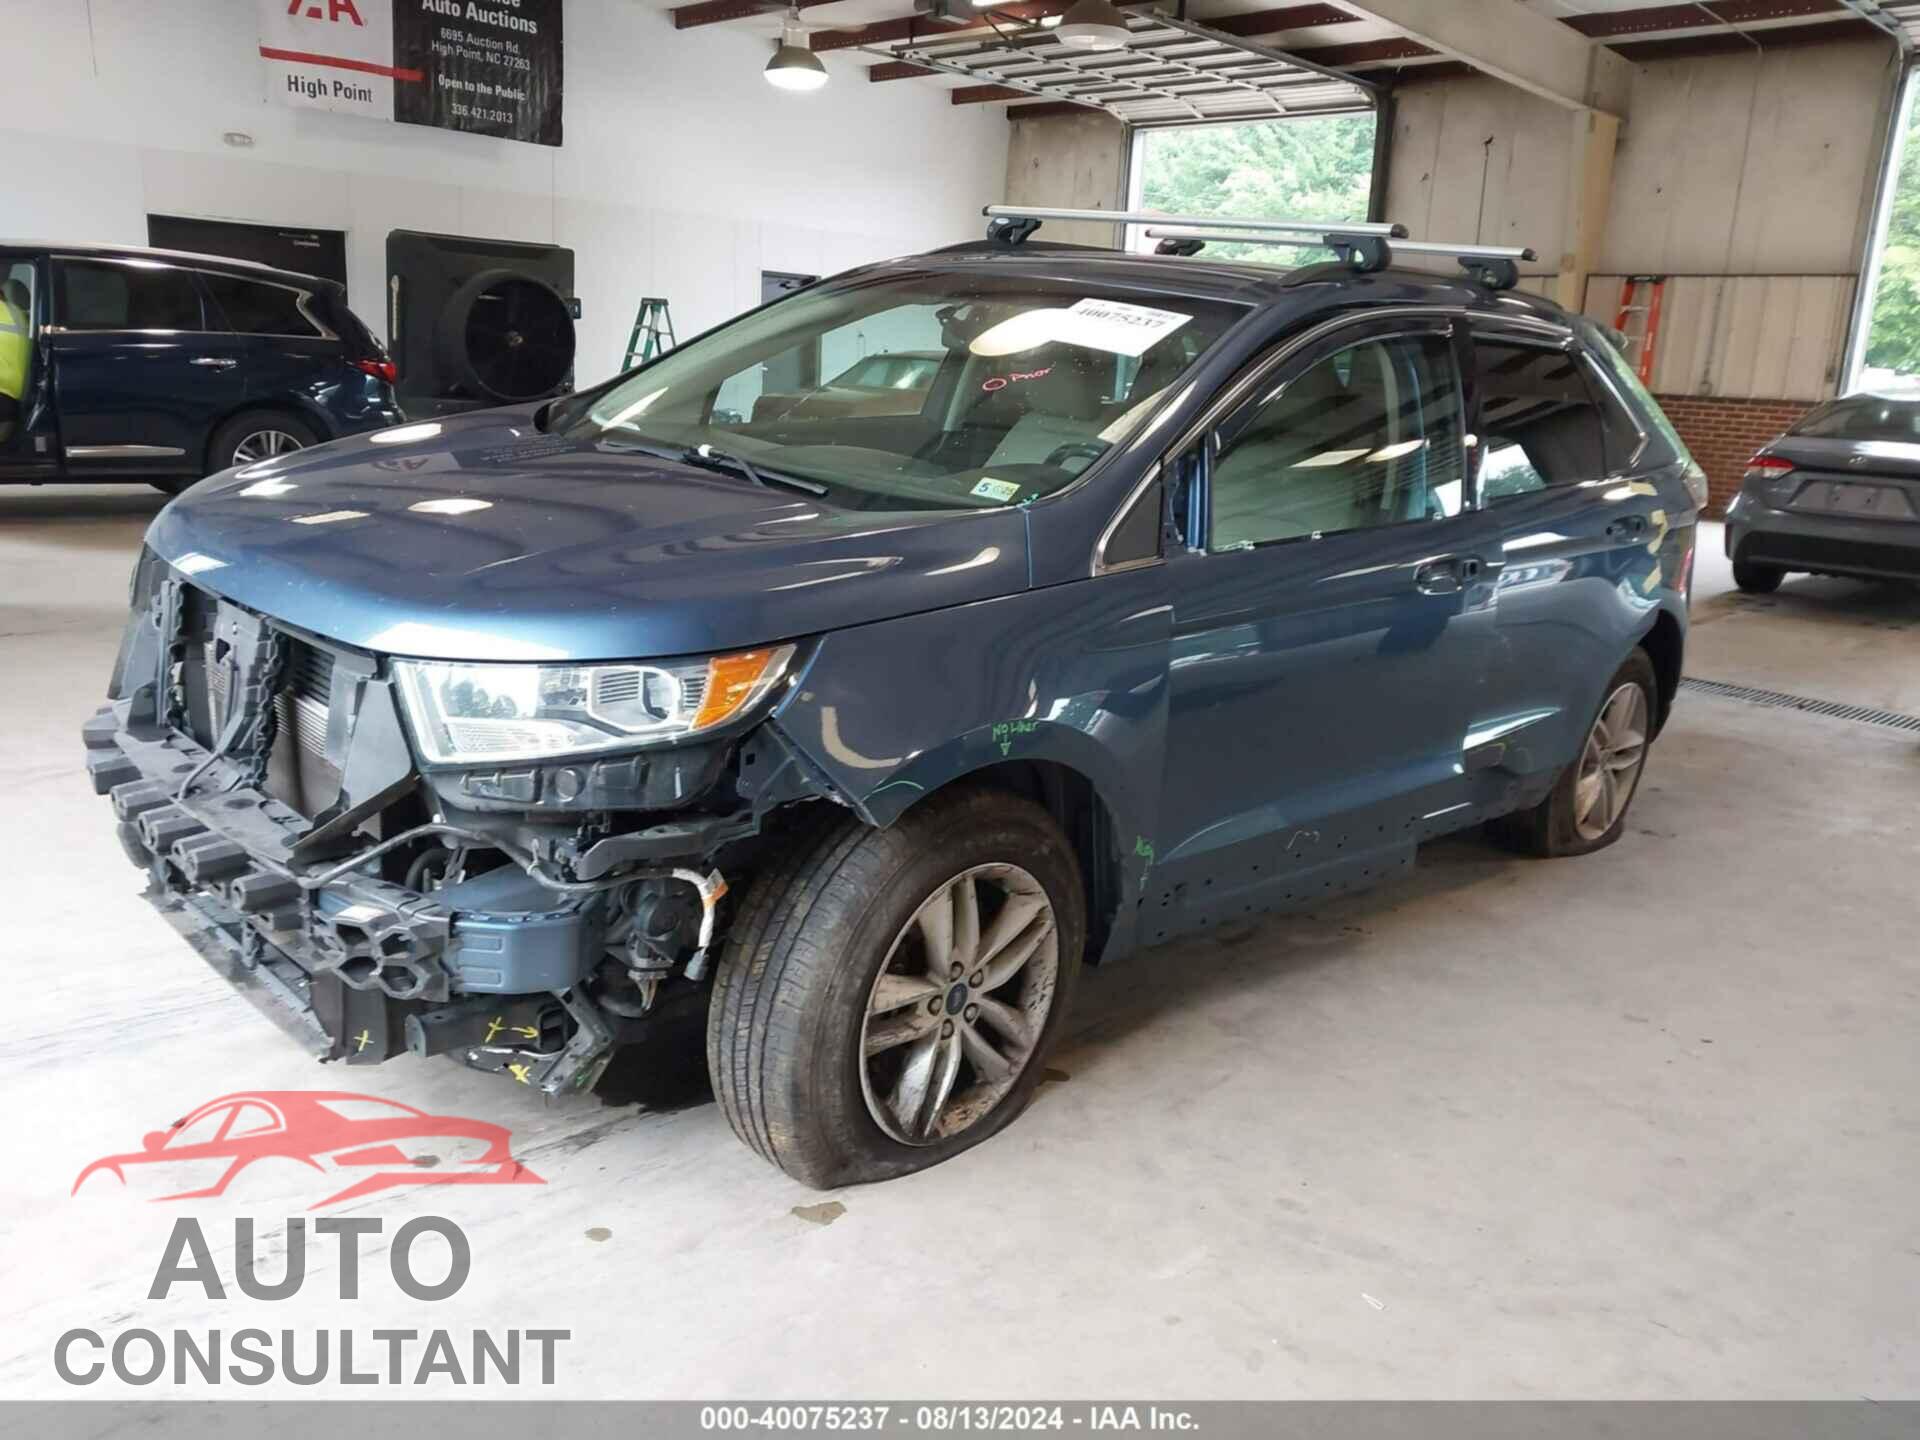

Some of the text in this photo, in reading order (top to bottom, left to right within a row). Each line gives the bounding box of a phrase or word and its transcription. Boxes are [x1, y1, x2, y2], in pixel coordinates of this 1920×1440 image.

[466, 2, 537, 34] Auctions
[432, 40, 454, 56] High
[486, 51, 500, 64] NC
[503, 54, 530, 71] 27263
[466, 33, 503, 49] Auction
[287, 74, 372, 103] High Point
[438, 74, 526, 101] Open to the Public
